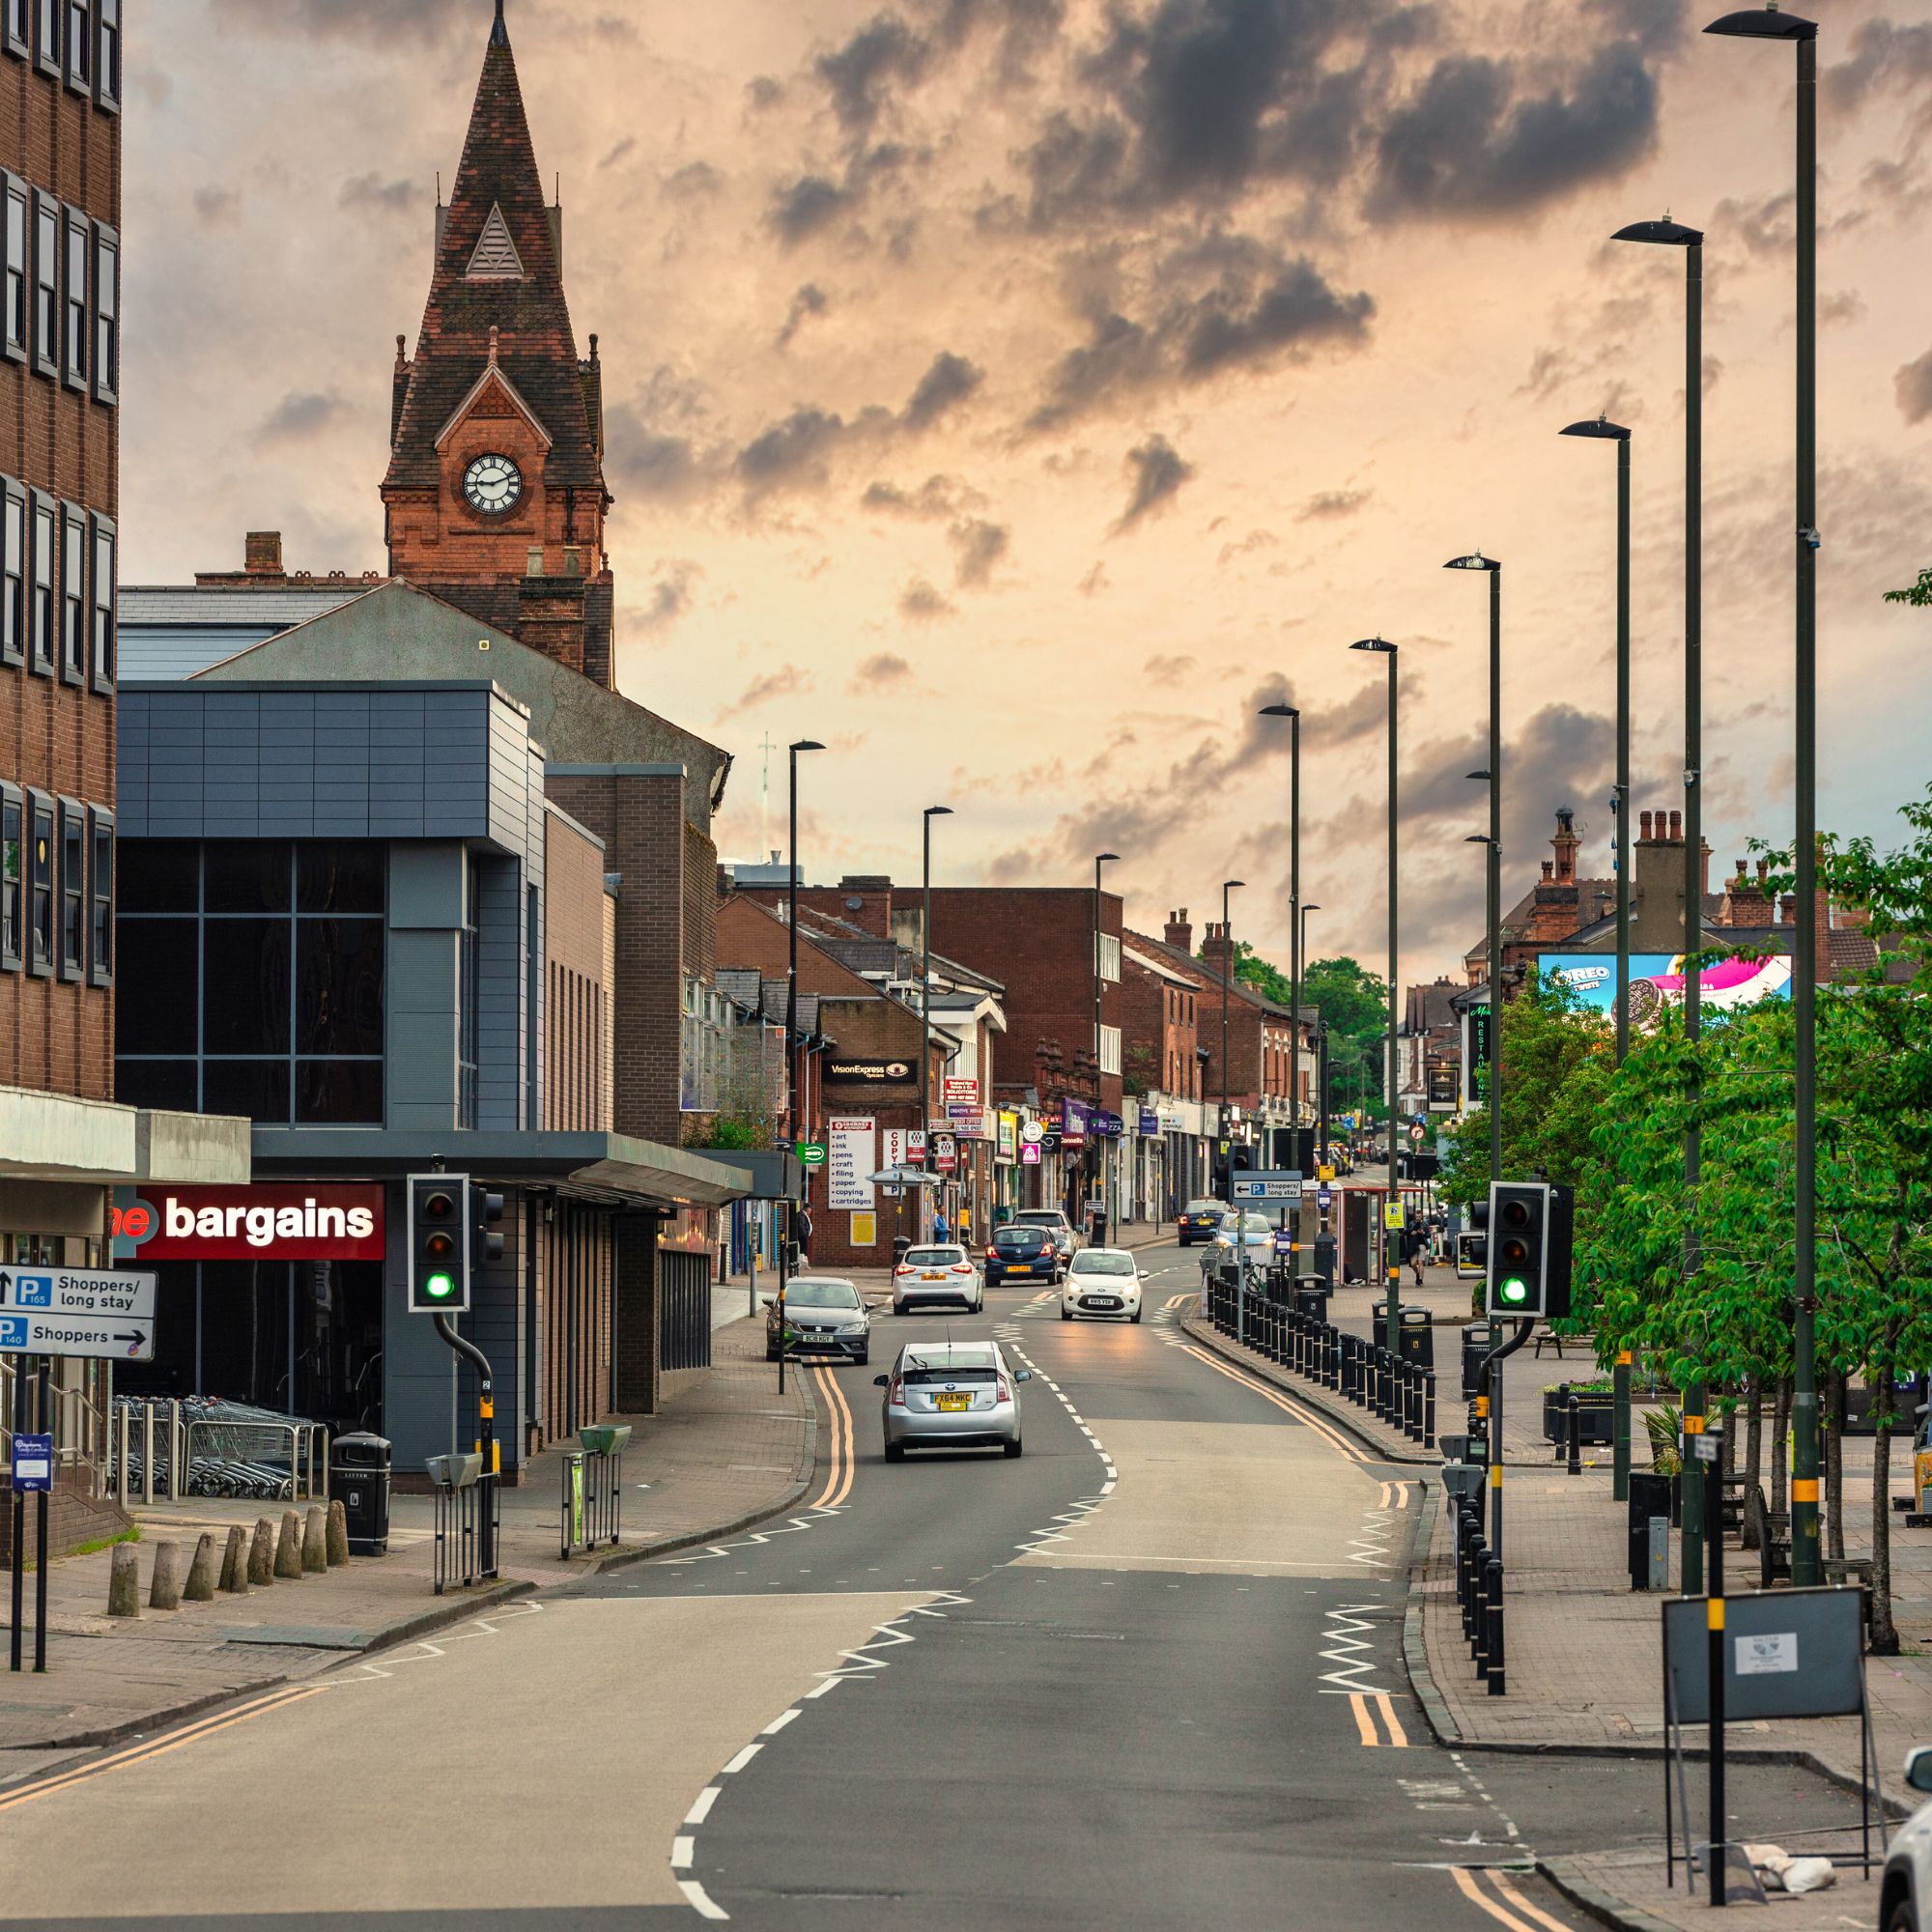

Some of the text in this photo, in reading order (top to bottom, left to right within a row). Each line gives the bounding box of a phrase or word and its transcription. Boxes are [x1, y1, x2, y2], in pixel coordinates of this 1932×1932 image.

[165, 1198, 374, 1246] bargains
[20, 1280, 45, 1304] P 165
[58, 1276, 140, 1294] Shoppers/
[61, 1293, 133, 1310] long stay
[33, 1326, 108, 1344] Shoppers
[934, 1394, 953, 1403] FX64
